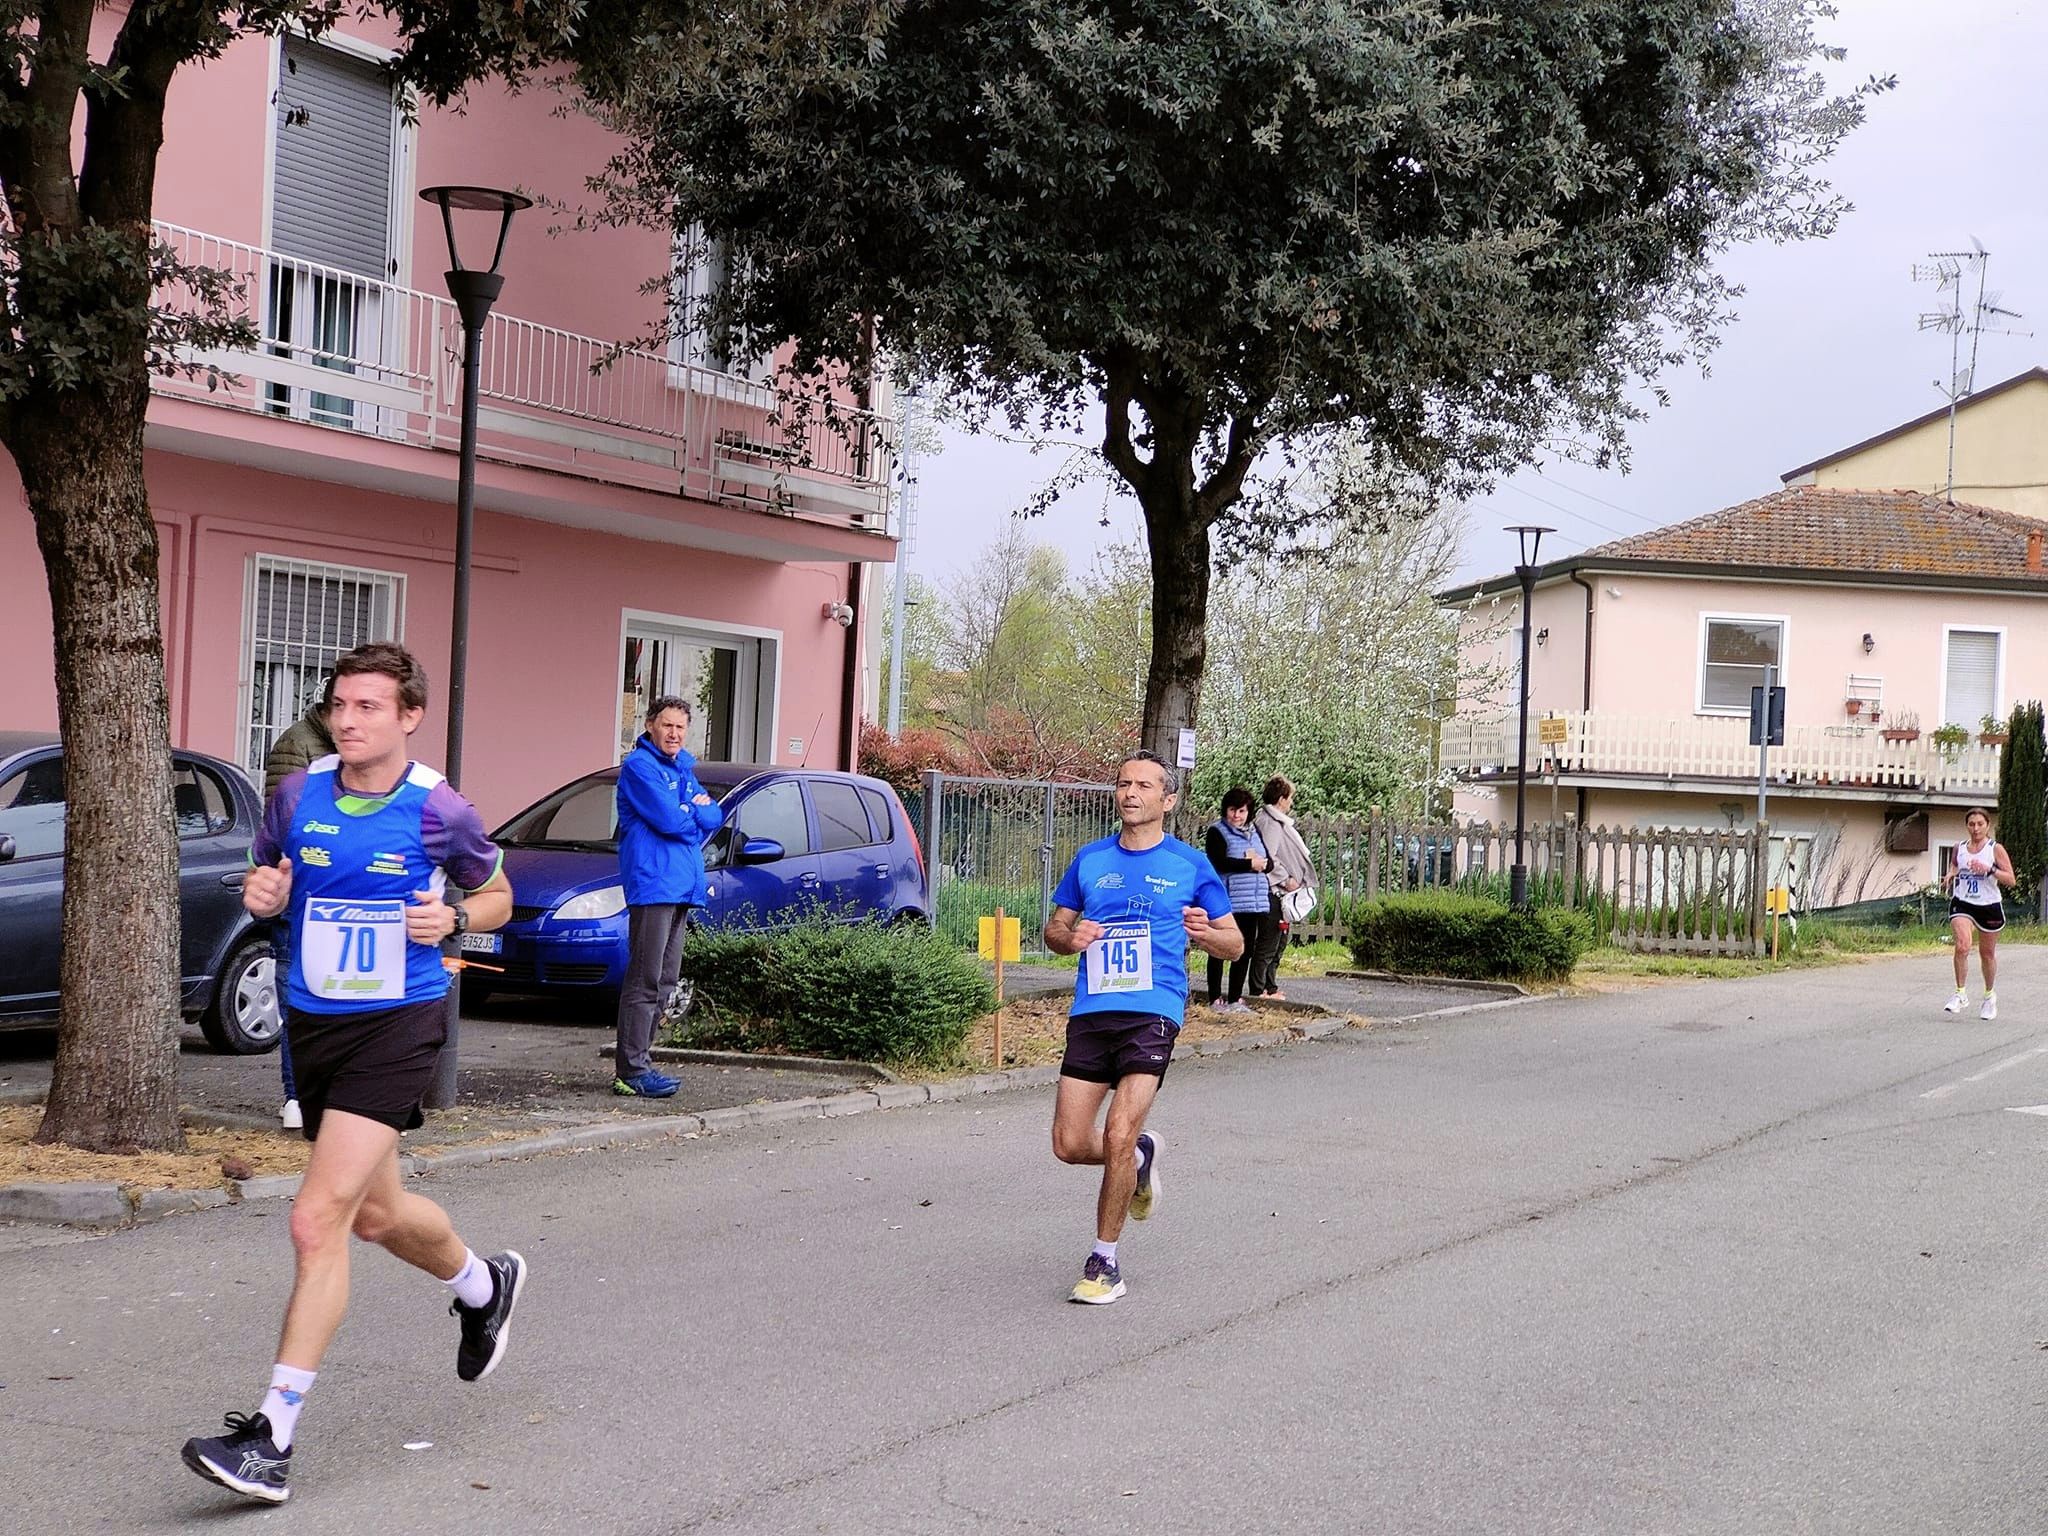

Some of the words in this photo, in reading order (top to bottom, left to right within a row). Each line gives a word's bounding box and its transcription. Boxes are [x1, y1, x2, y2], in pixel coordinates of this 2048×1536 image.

[1967, 880, 1978, 893] 28
[1108, 928, 1147, 937] Mizuno
[338, 926, 375, 972] 70
[1101, 941, 1138, 974] 145
